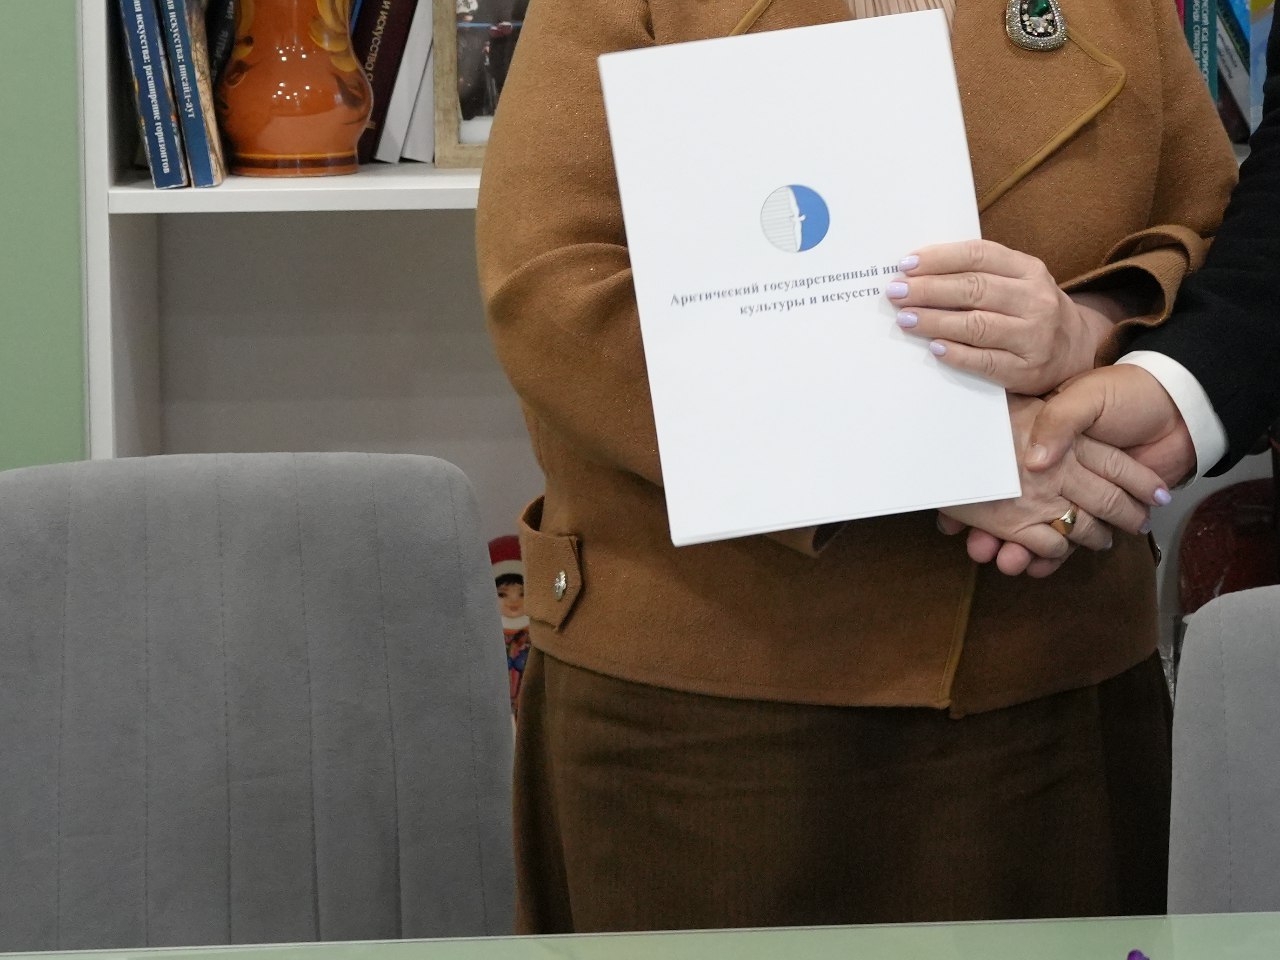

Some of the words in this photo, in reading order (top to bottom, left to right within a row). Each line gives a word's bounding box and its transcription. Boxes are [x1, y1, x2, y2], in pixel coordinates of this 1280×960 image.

[133, 13, 152, 63] искусства:
[364, 10, 387, 71] искусства
[165, 11, 186, 63] искусства:
[176, 63, 197, 119] инсайд-аут
[141, 64, 161, 120] расширение
[152, 121, 172, 173] горизонтов
[670, 283, 760, 307] Арктический
[763, 266, 879, 292] государственный
[882, 264, 901, 276] ин
[739, 297, 806, 316] культуры
[809, 296, 818, 305] и
[821, 286, 881, 304] искусств
